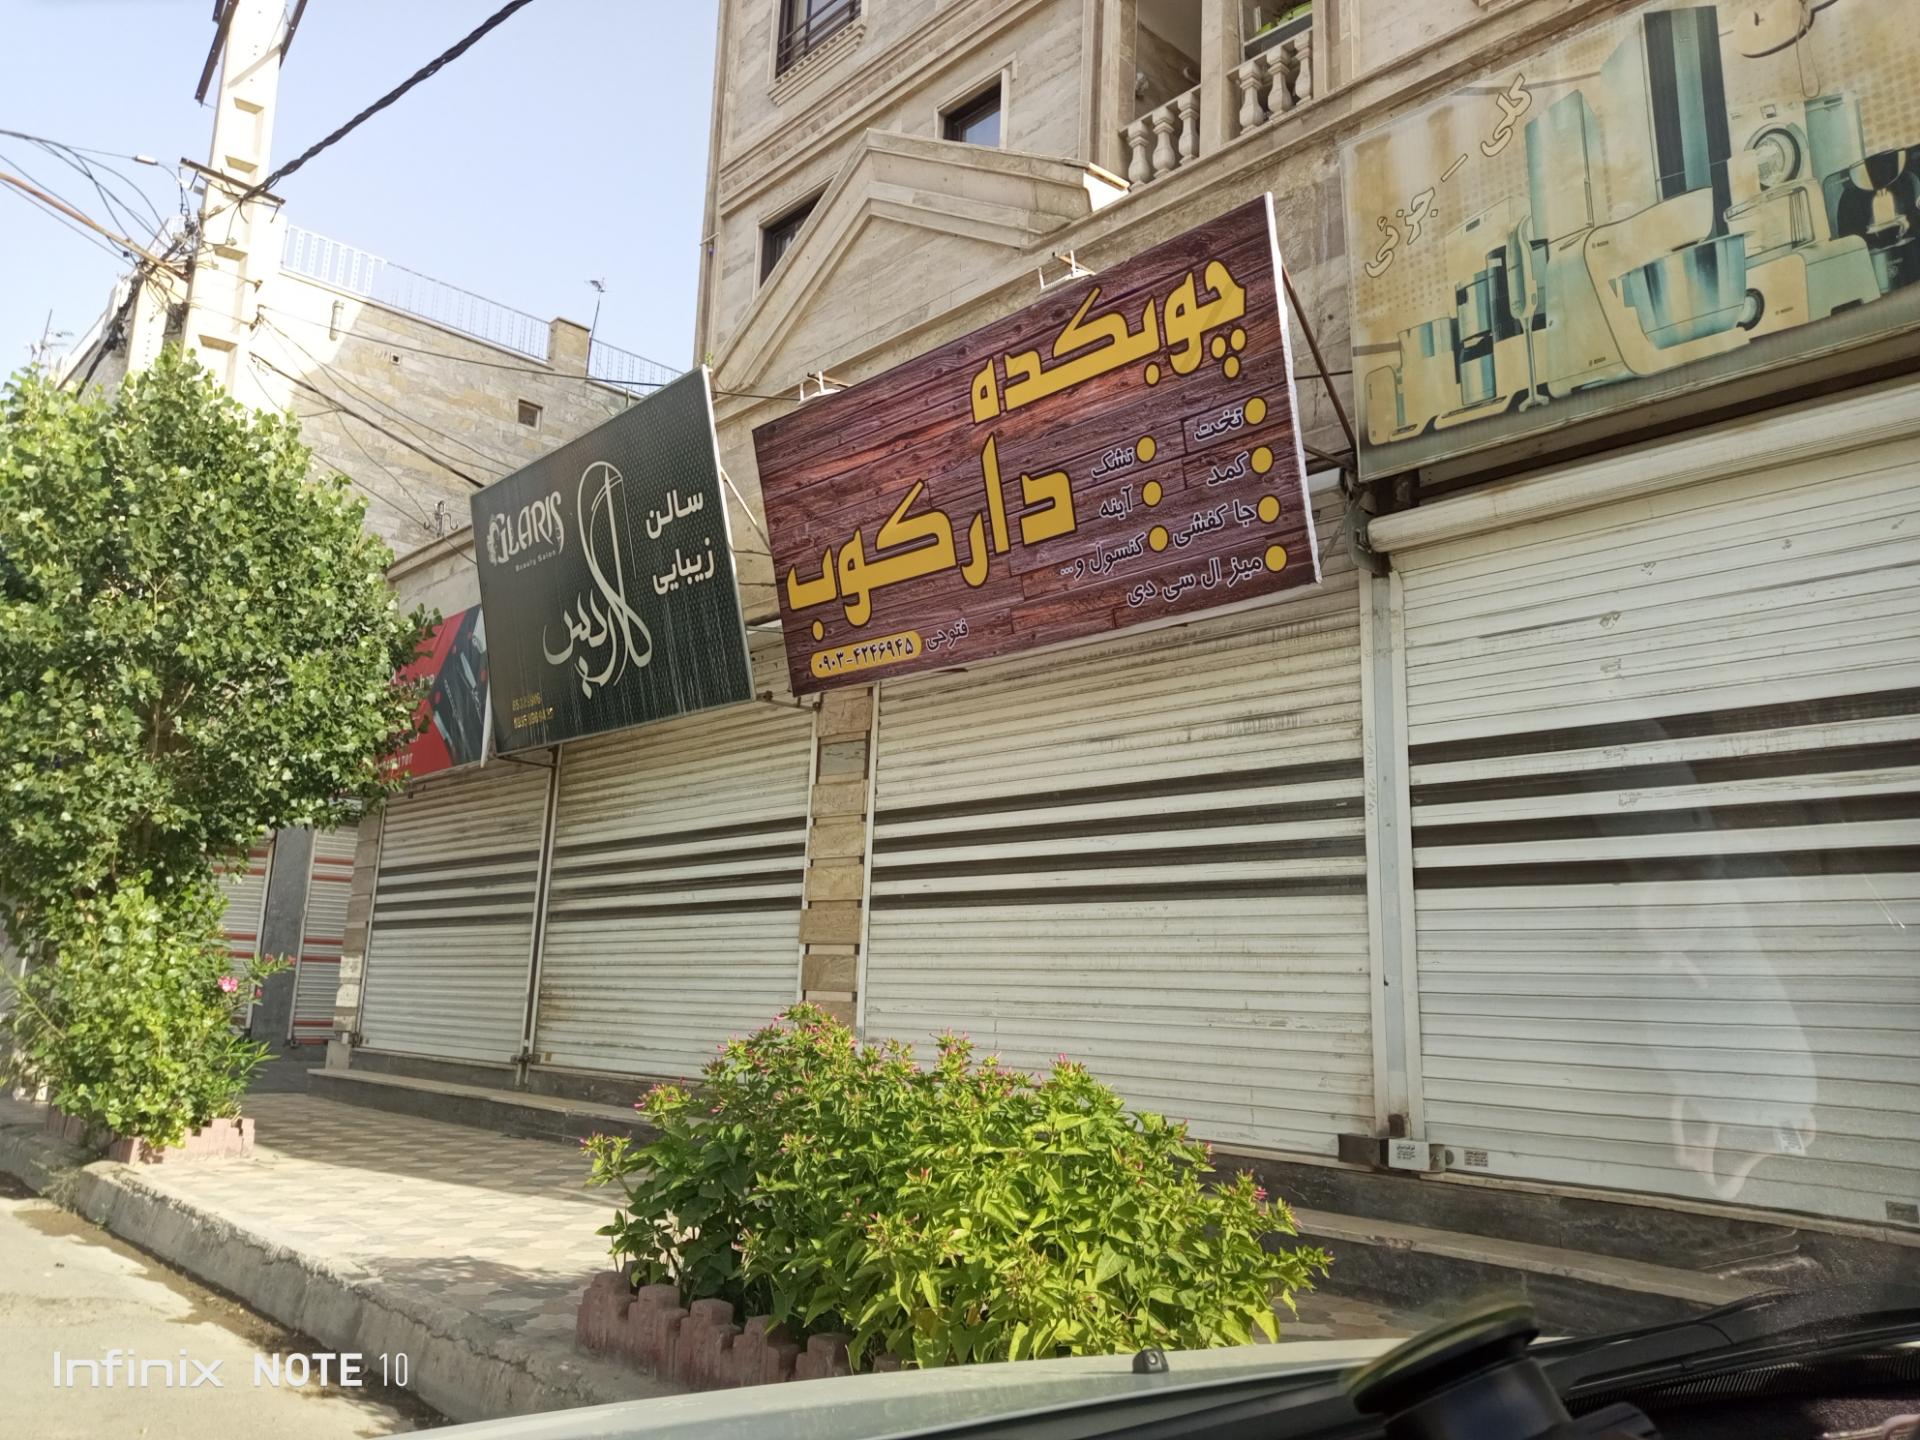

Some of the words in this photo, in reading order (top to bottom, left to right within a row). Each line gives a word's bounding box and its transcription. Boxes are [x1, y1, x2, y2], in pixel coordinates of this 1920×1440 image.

[1480, 73, 1532, 157] کلی
[970, 259, 1247, 425] چوبکده
[1194, 407, 1243, 441] تخت
[1091, 447, 1134, 478] تشک
[1207, 452, 1249, 486] کمد
[645, 489, 704, 539] سالن
[1100, 485, 1133, 520] آینه
[1234, 500, 1257, 528] جا
[785, 432, 1078, 643] دارکوب
[1173, 504, 1228, 547] کفشی
[652, 537, 715, 595] زیبایی
[1089, 532, 1146, 574] کنسول
[1162, 572, 1195, 601] سی
[1202, 557, 1222, 588] ال
[1227, 555, 1263, 587] میز
[1127, 579, 1157, 607] دی
[925, 618, 969, 651] فتوحی
